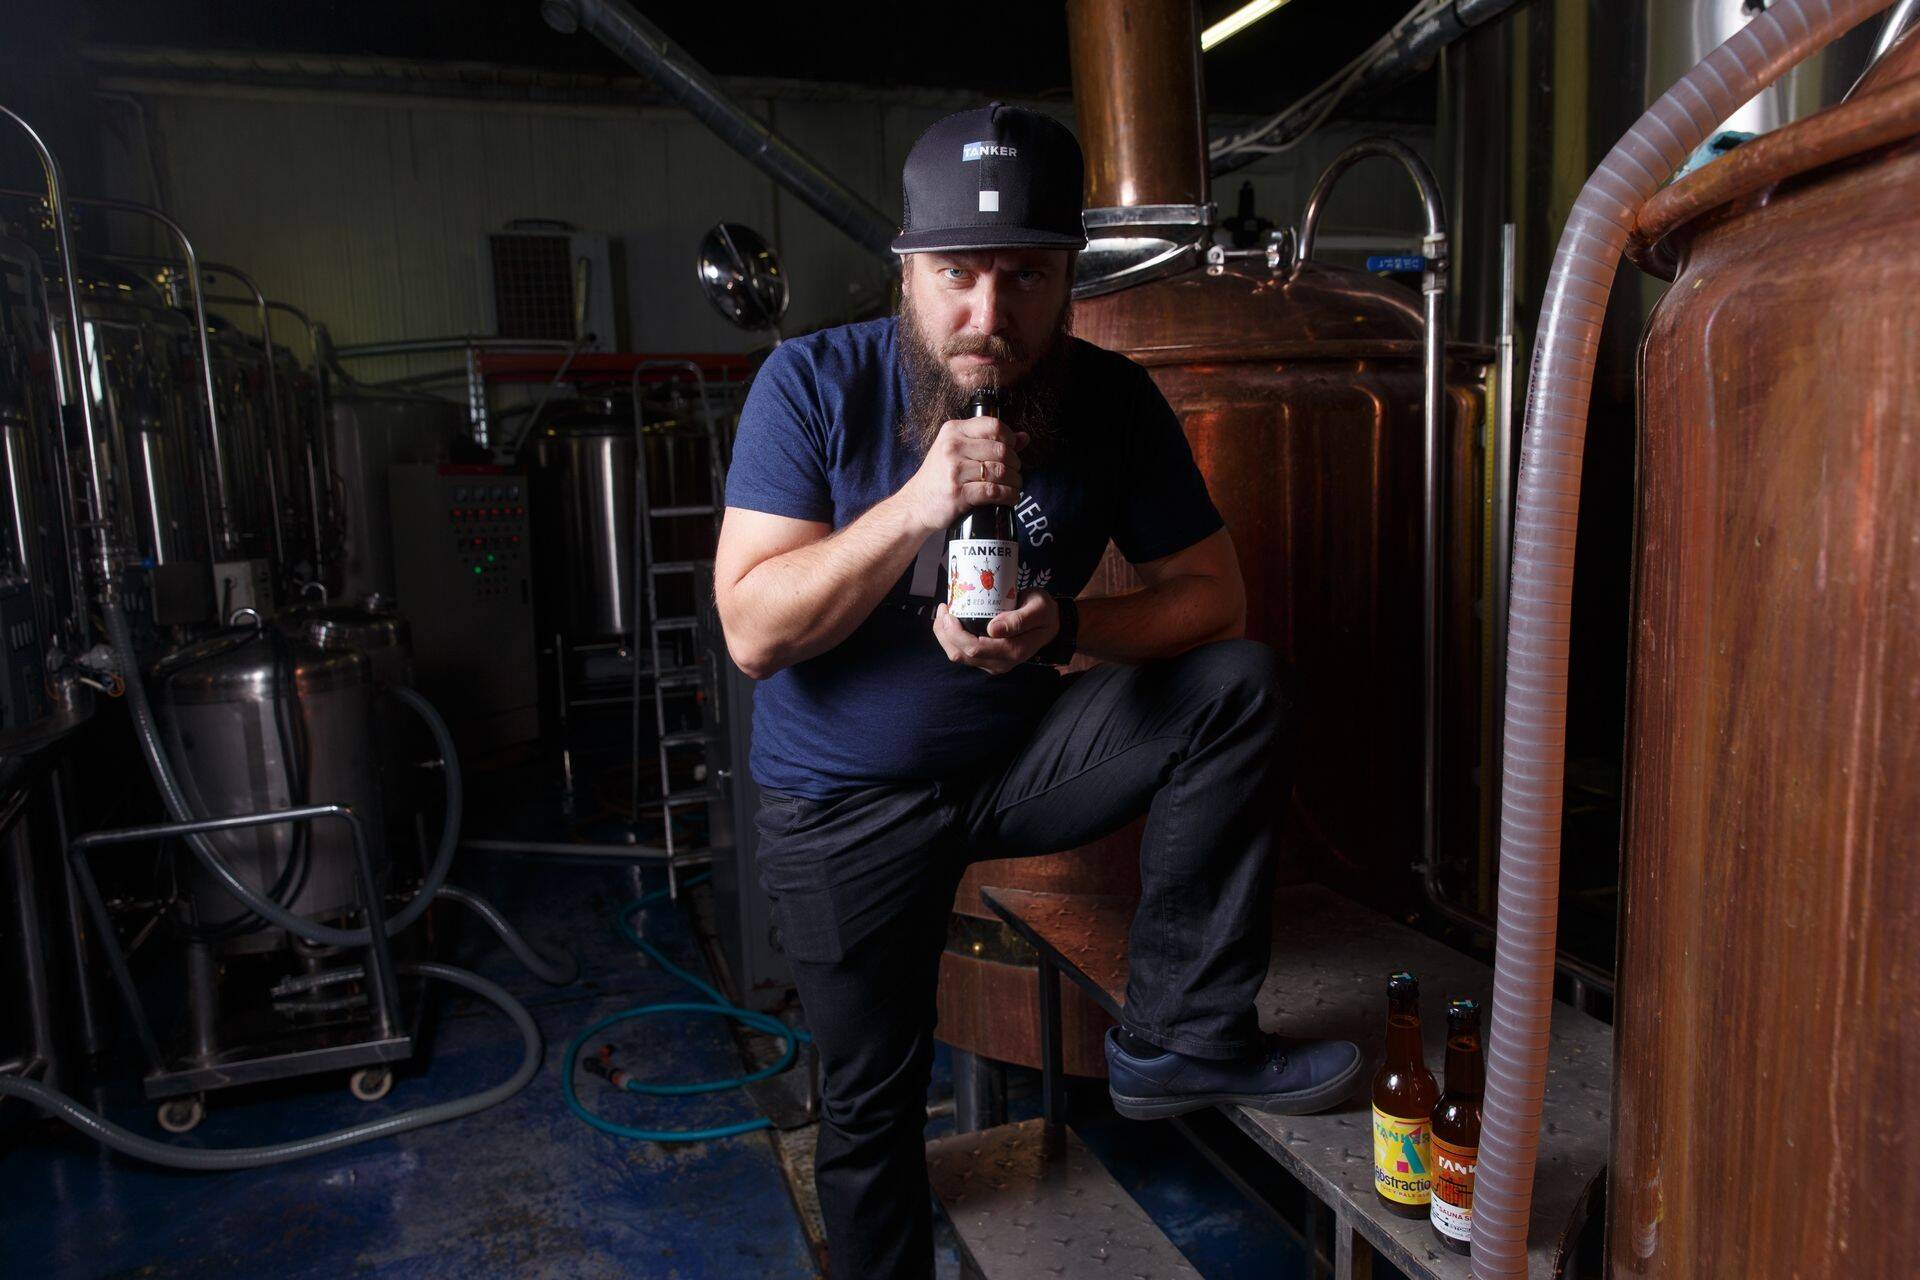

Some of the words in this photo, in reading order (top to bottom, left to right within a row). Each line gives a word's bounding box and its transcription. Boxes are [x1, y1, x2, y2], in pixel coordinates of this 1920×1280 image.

[963, 146, 1017, 157] TANKER
[1014, 491, 1054, 547] NERS
[962, 546, 1012, 557] TANKER
[1438, 1155, 1477, 1175] TANK
